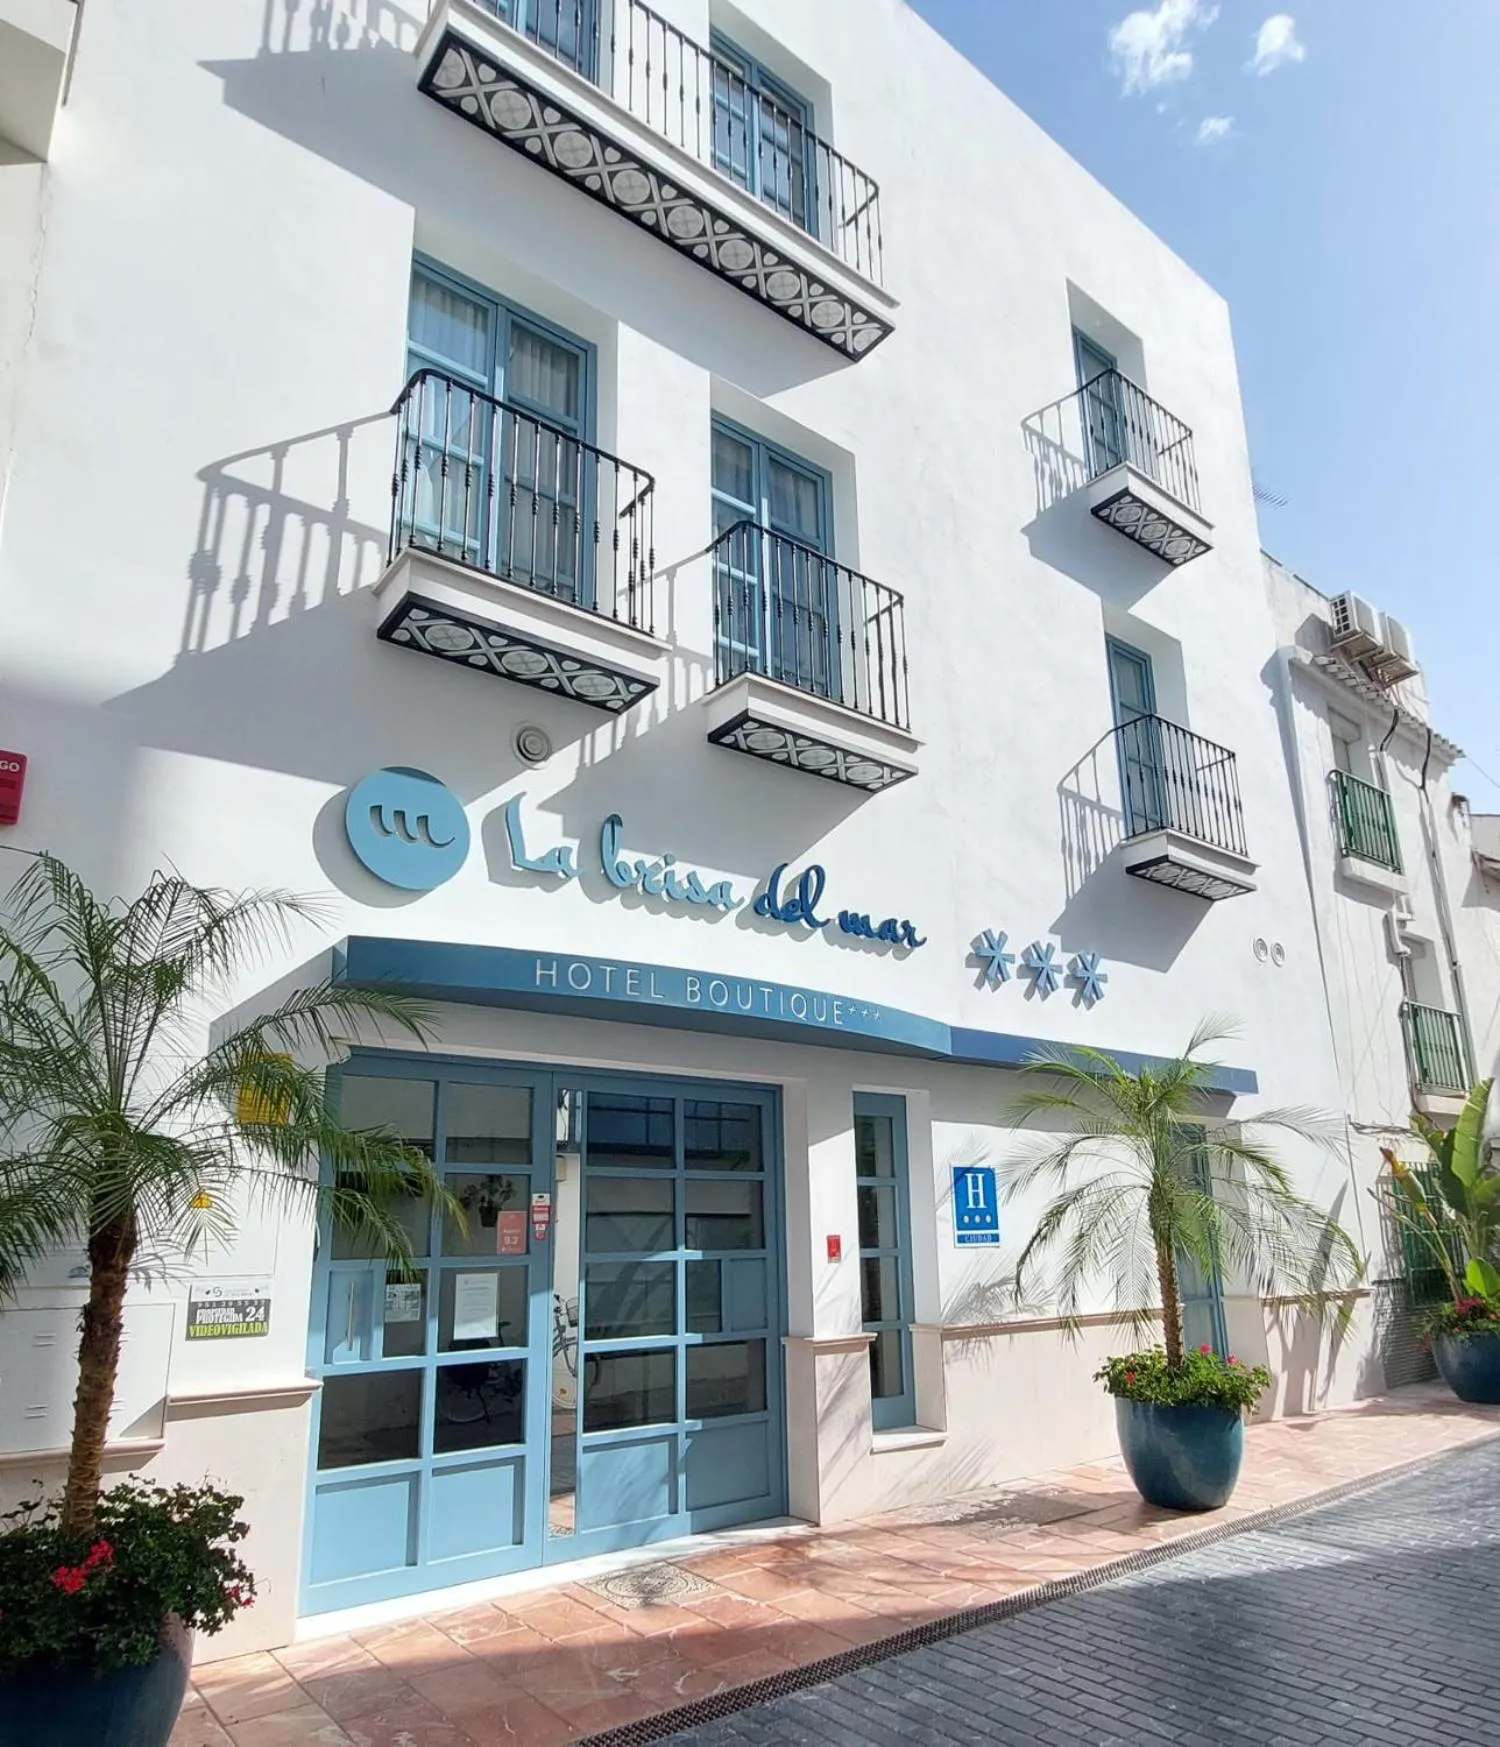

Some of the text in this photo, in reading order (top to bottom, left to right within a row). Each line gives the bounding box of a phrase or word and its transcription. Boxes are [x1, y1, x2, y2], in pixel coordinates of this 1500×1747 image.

[505, 791, 927, 948] La brisa del mar
[535, 959, 664, 998] HOTEL
[965, 1173, 987, 1209] H
[189, 1321, 268, 1337] VIDEOVIGILADA
